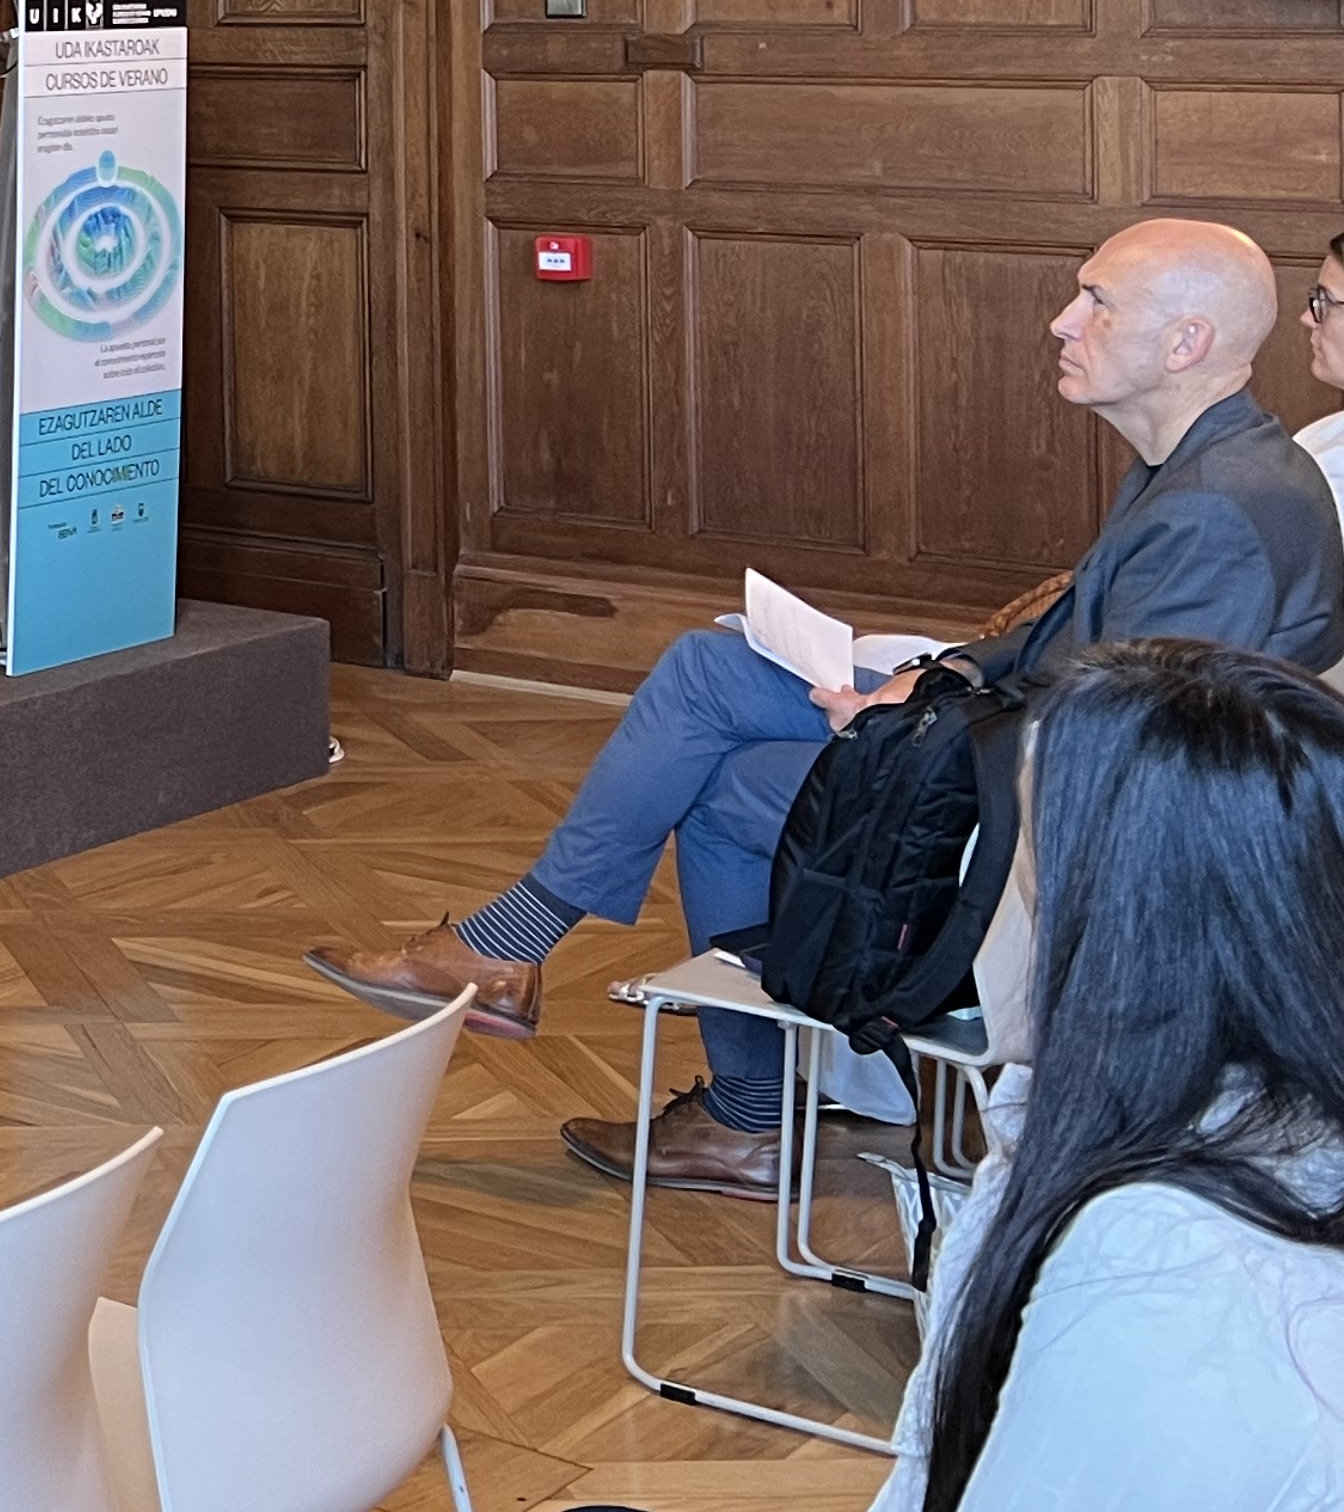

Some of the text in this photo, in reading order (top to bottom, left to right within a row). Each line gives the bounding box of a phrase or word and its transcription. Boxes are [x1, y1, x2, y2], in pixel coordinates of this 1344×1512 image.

[55, 38, 161, 59] UDA IKASTAROAK
[46, 67, 169, 92] CURSOS DE VERANO
[39, 399, 163, 436] EZAGUTZAREN ALDE
[71, 434, 133, 461] DEL LADO
[39, 458, 160, 499] DEL CONOCIMIENTO
